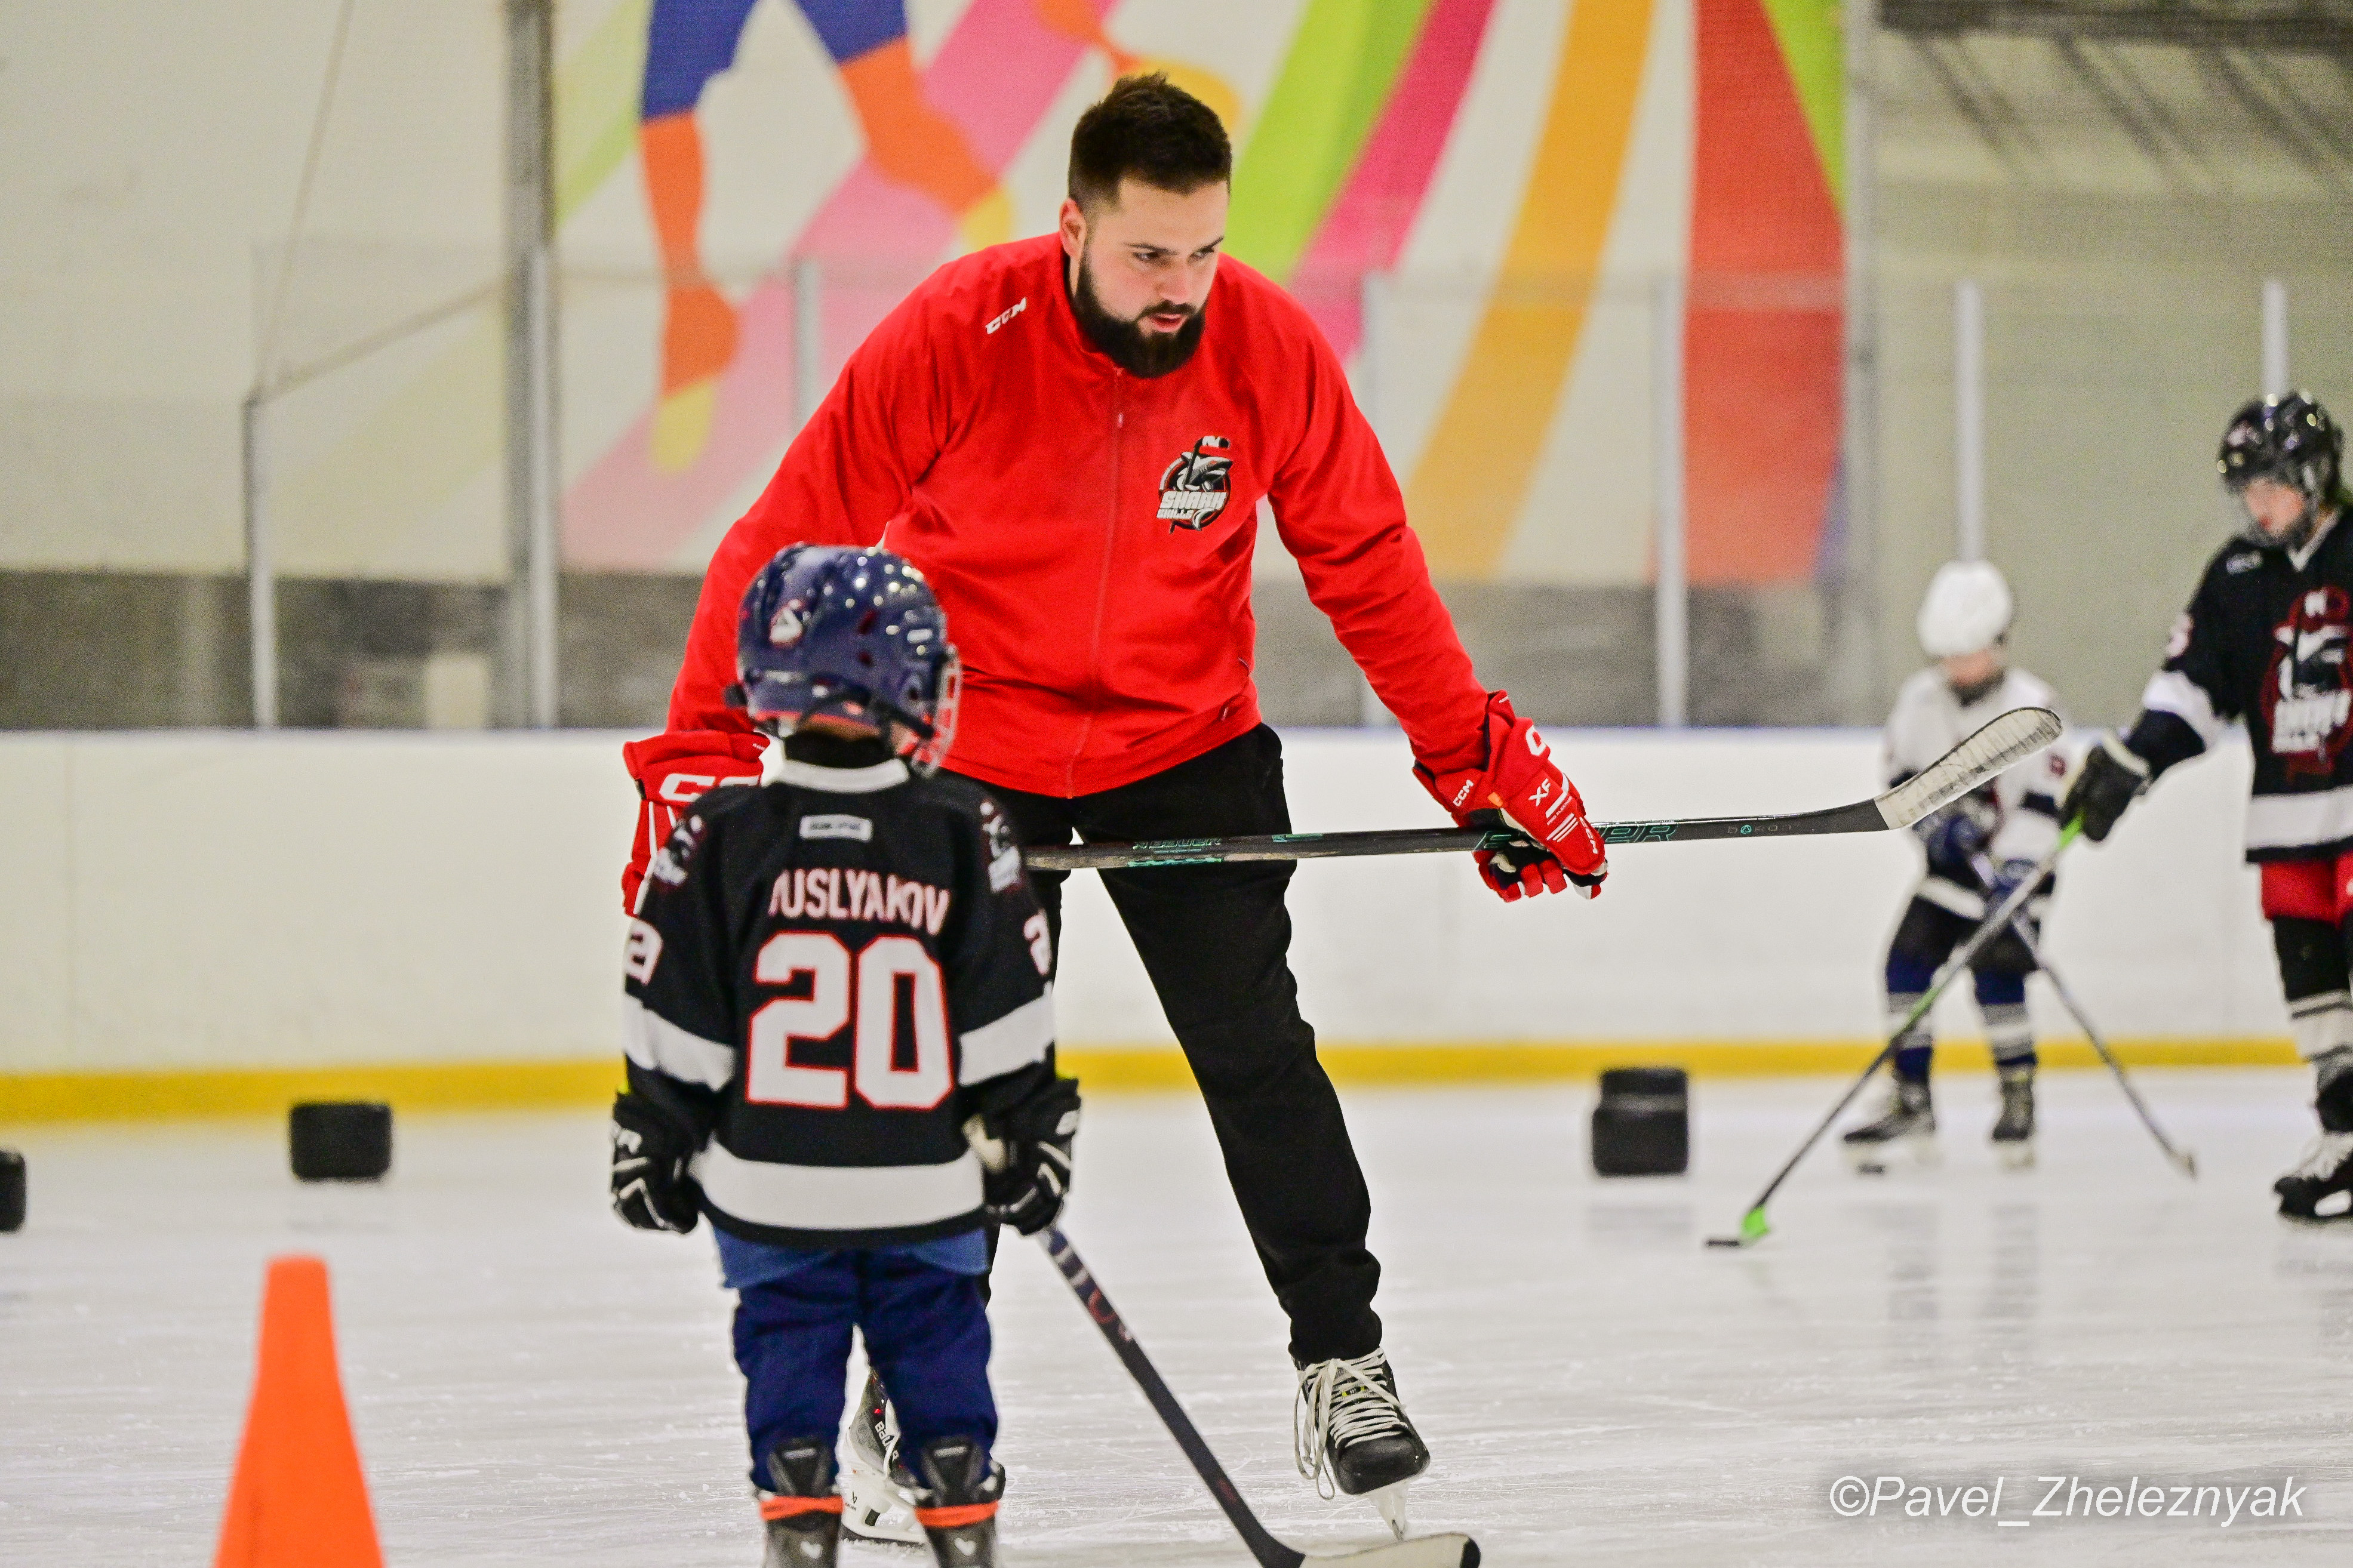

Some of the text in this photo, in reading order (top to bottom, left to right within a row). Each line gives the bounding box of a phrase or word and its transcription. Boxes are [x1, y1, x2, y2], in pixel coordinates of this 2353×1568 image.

[985, 296, 1027, 335] CCM
[1453, 779, 1474, 807] CCM
[1528, 778, 1551, 807] XF
[746, 930, 953, 1110] 20
